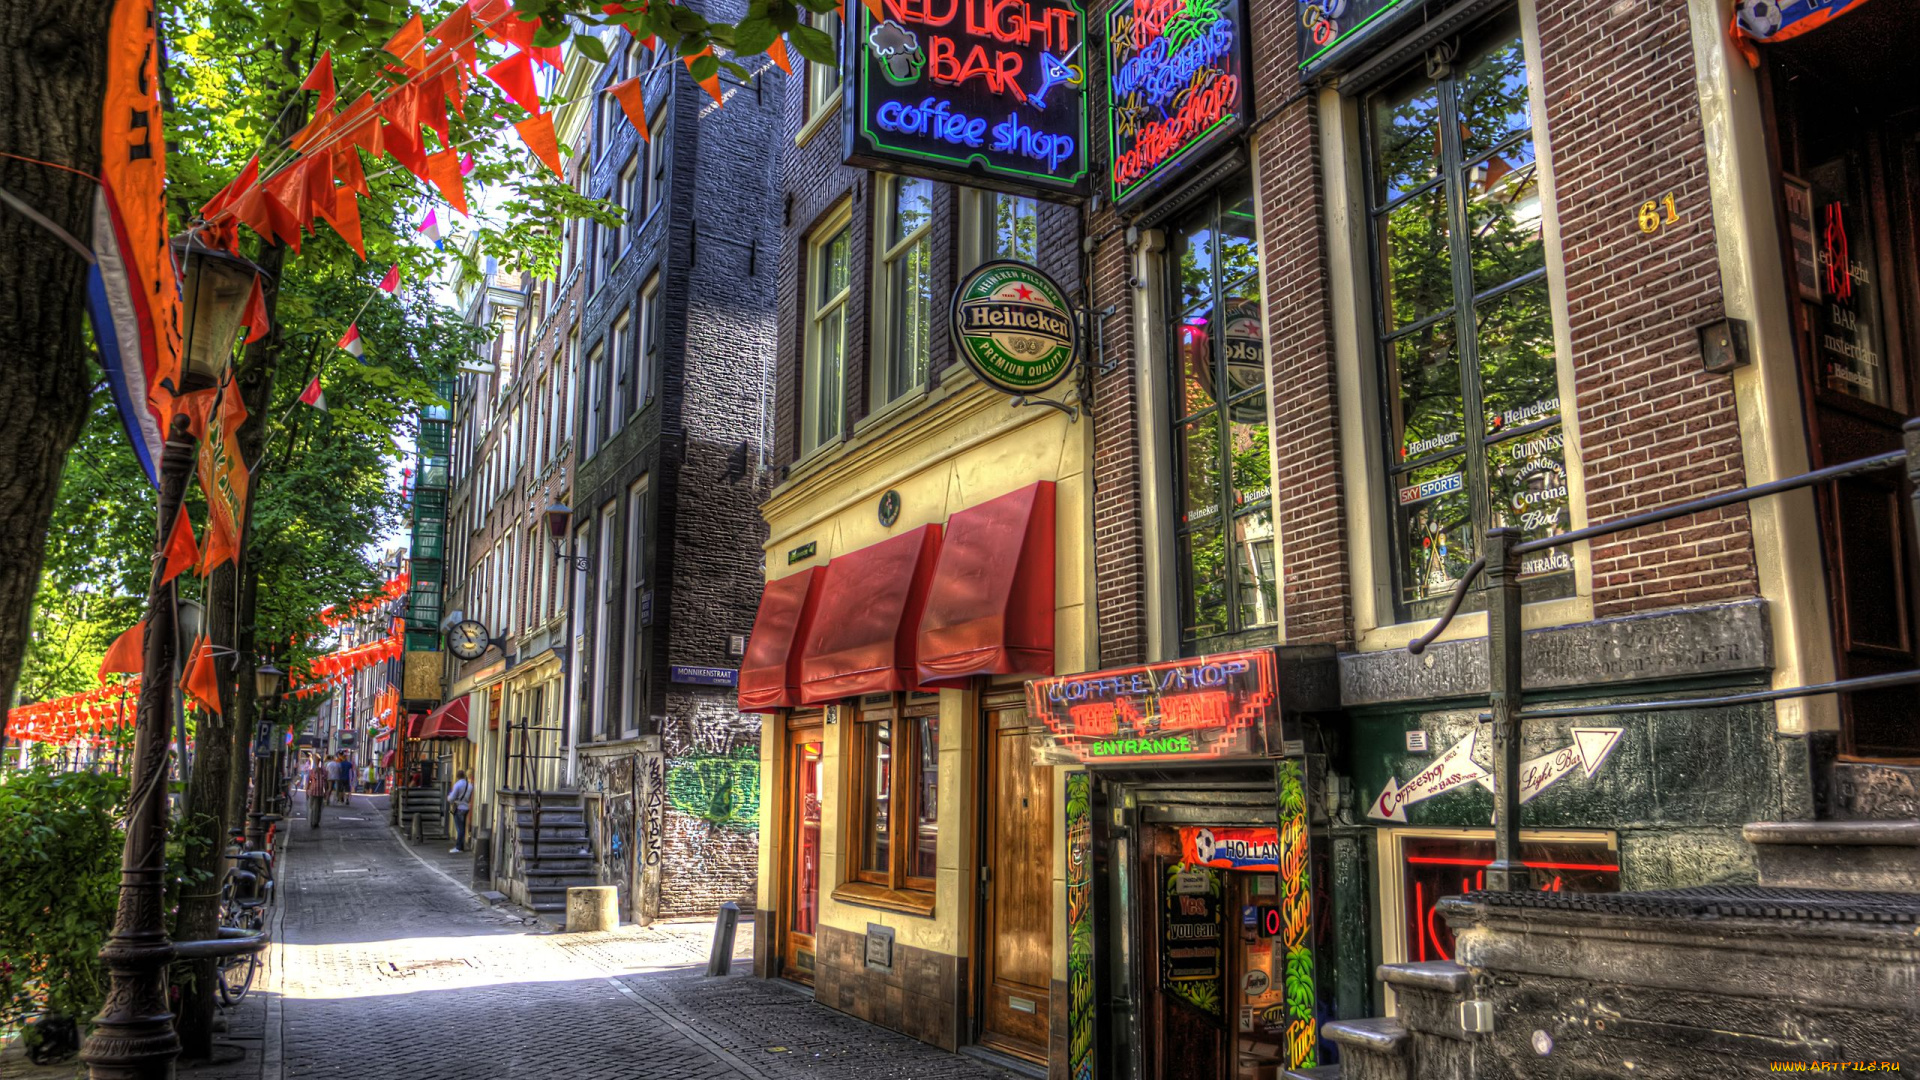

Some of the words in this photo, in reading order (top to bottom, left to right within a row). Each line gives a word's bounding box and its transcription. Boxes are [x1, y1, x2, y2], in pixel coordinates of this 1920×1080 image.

[965, 0, 1076, 51] LIGHT
[928, 34, 1028, 105] BAR
[1112, 37, 1166, 96] VIDEO
[1147, 20, 1227, 104] SCREENS
[876, 97, 986, 146] coffee
[992, 112, 1075, 172] shop
[1638, 192, 1680, 234] 61
[978, 271, 1019, 293] HEINEKEN
[1021, 272, 1058, 302] PILSENER
[971, 306, 1069, 338] Heineken
[1832, 303, 1857, 333] BAR
[979, 342, 1025, 376] PREMIUM
[1029, 350, 1063, 377] QUALITY
[1824, 334, 1878, 368] msterdam
[1503, 398, 1560, 425] Heineken
[1408, 432, 1460, 455] Heineken
[1512, 433, 1564, 460] GUINNESS
[1513, 456, 1567, 486] STRONGBOW
[1244, 486, 1272, 503] Heinek
[1401, 485, 1420, 503] SKY
[1421, 475, 1461, 497] SPORTS
[1512, 485, 1567, 510] Corona
[1188, 504, 1219, 521] Heineken
[1520, 507, 1561, 531] Bud
[1522, 554, 1568, 574] ENTRANCE
[678, 668, 731, 678] MONNIKENSTRAAT
[1050, 673, 1149, 701] COFFEE
[261, 723, 268, 741] P
[1093, 737, 1191, 755] ENTRANCE
[1521, 761, 1552, 792] Light
[1556, 748, 1581, 770] Bar
[1380, 762, 1445, 817] Coffeeshop
[1226, 840, 1278, 859] HOLLAN
[1281, 813, 1309, 897] Coffee
[1180, 895, 1208, 917] Yes,
[1282, 889, 1311, 947] Shop
[1171, 924, 1193, 939] you
[1194, 923, 1216, 938] can
[1286, 1018, 1315, 1070] Juice
